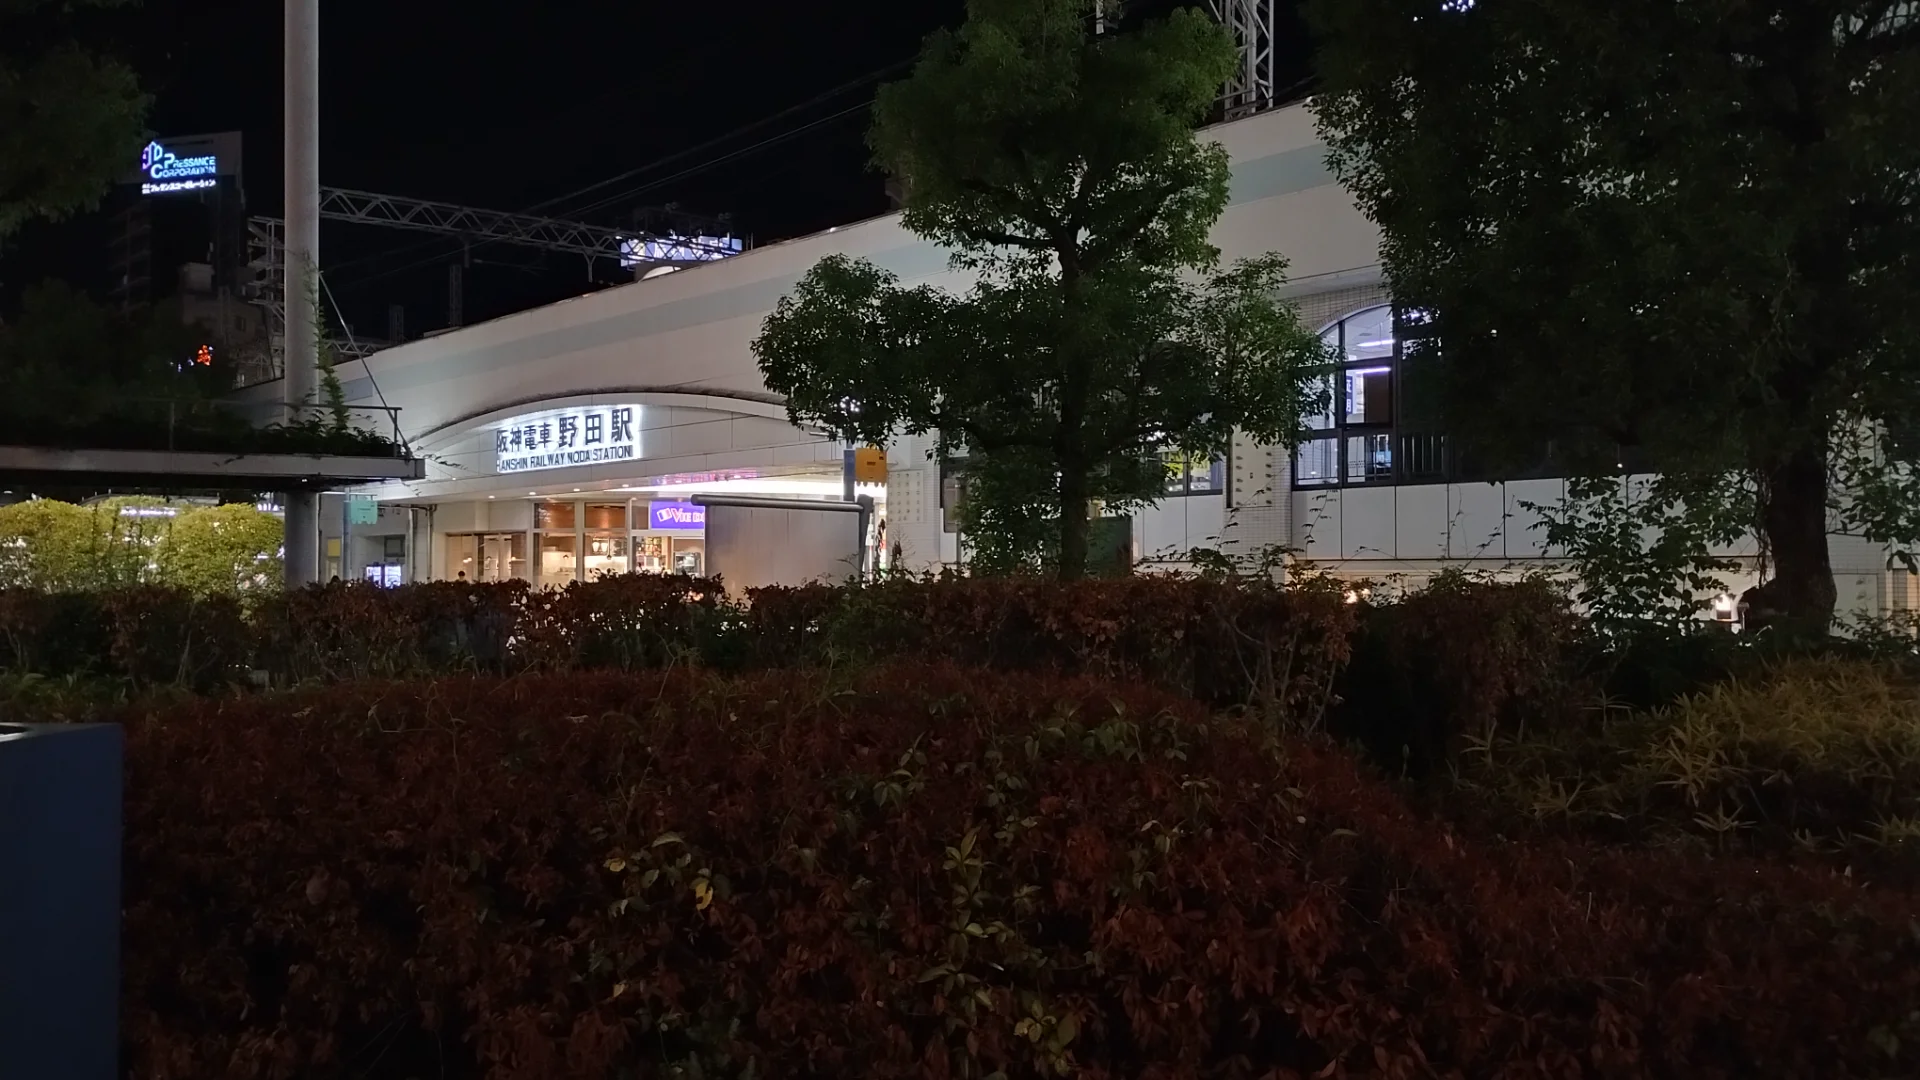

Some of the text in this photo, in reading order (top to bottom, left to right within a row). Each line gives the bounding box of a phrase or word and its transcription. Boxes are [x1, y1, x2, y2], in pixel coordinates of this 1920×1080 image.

[496, 407, 633, 453] 阪神電車 野田駅
[530, 453, 566, 468] RAILWAY
[567, 449, 591, 464] NODA
[592, 444, 633, 461] STATION
[671, 507, 692, 523] VIE
